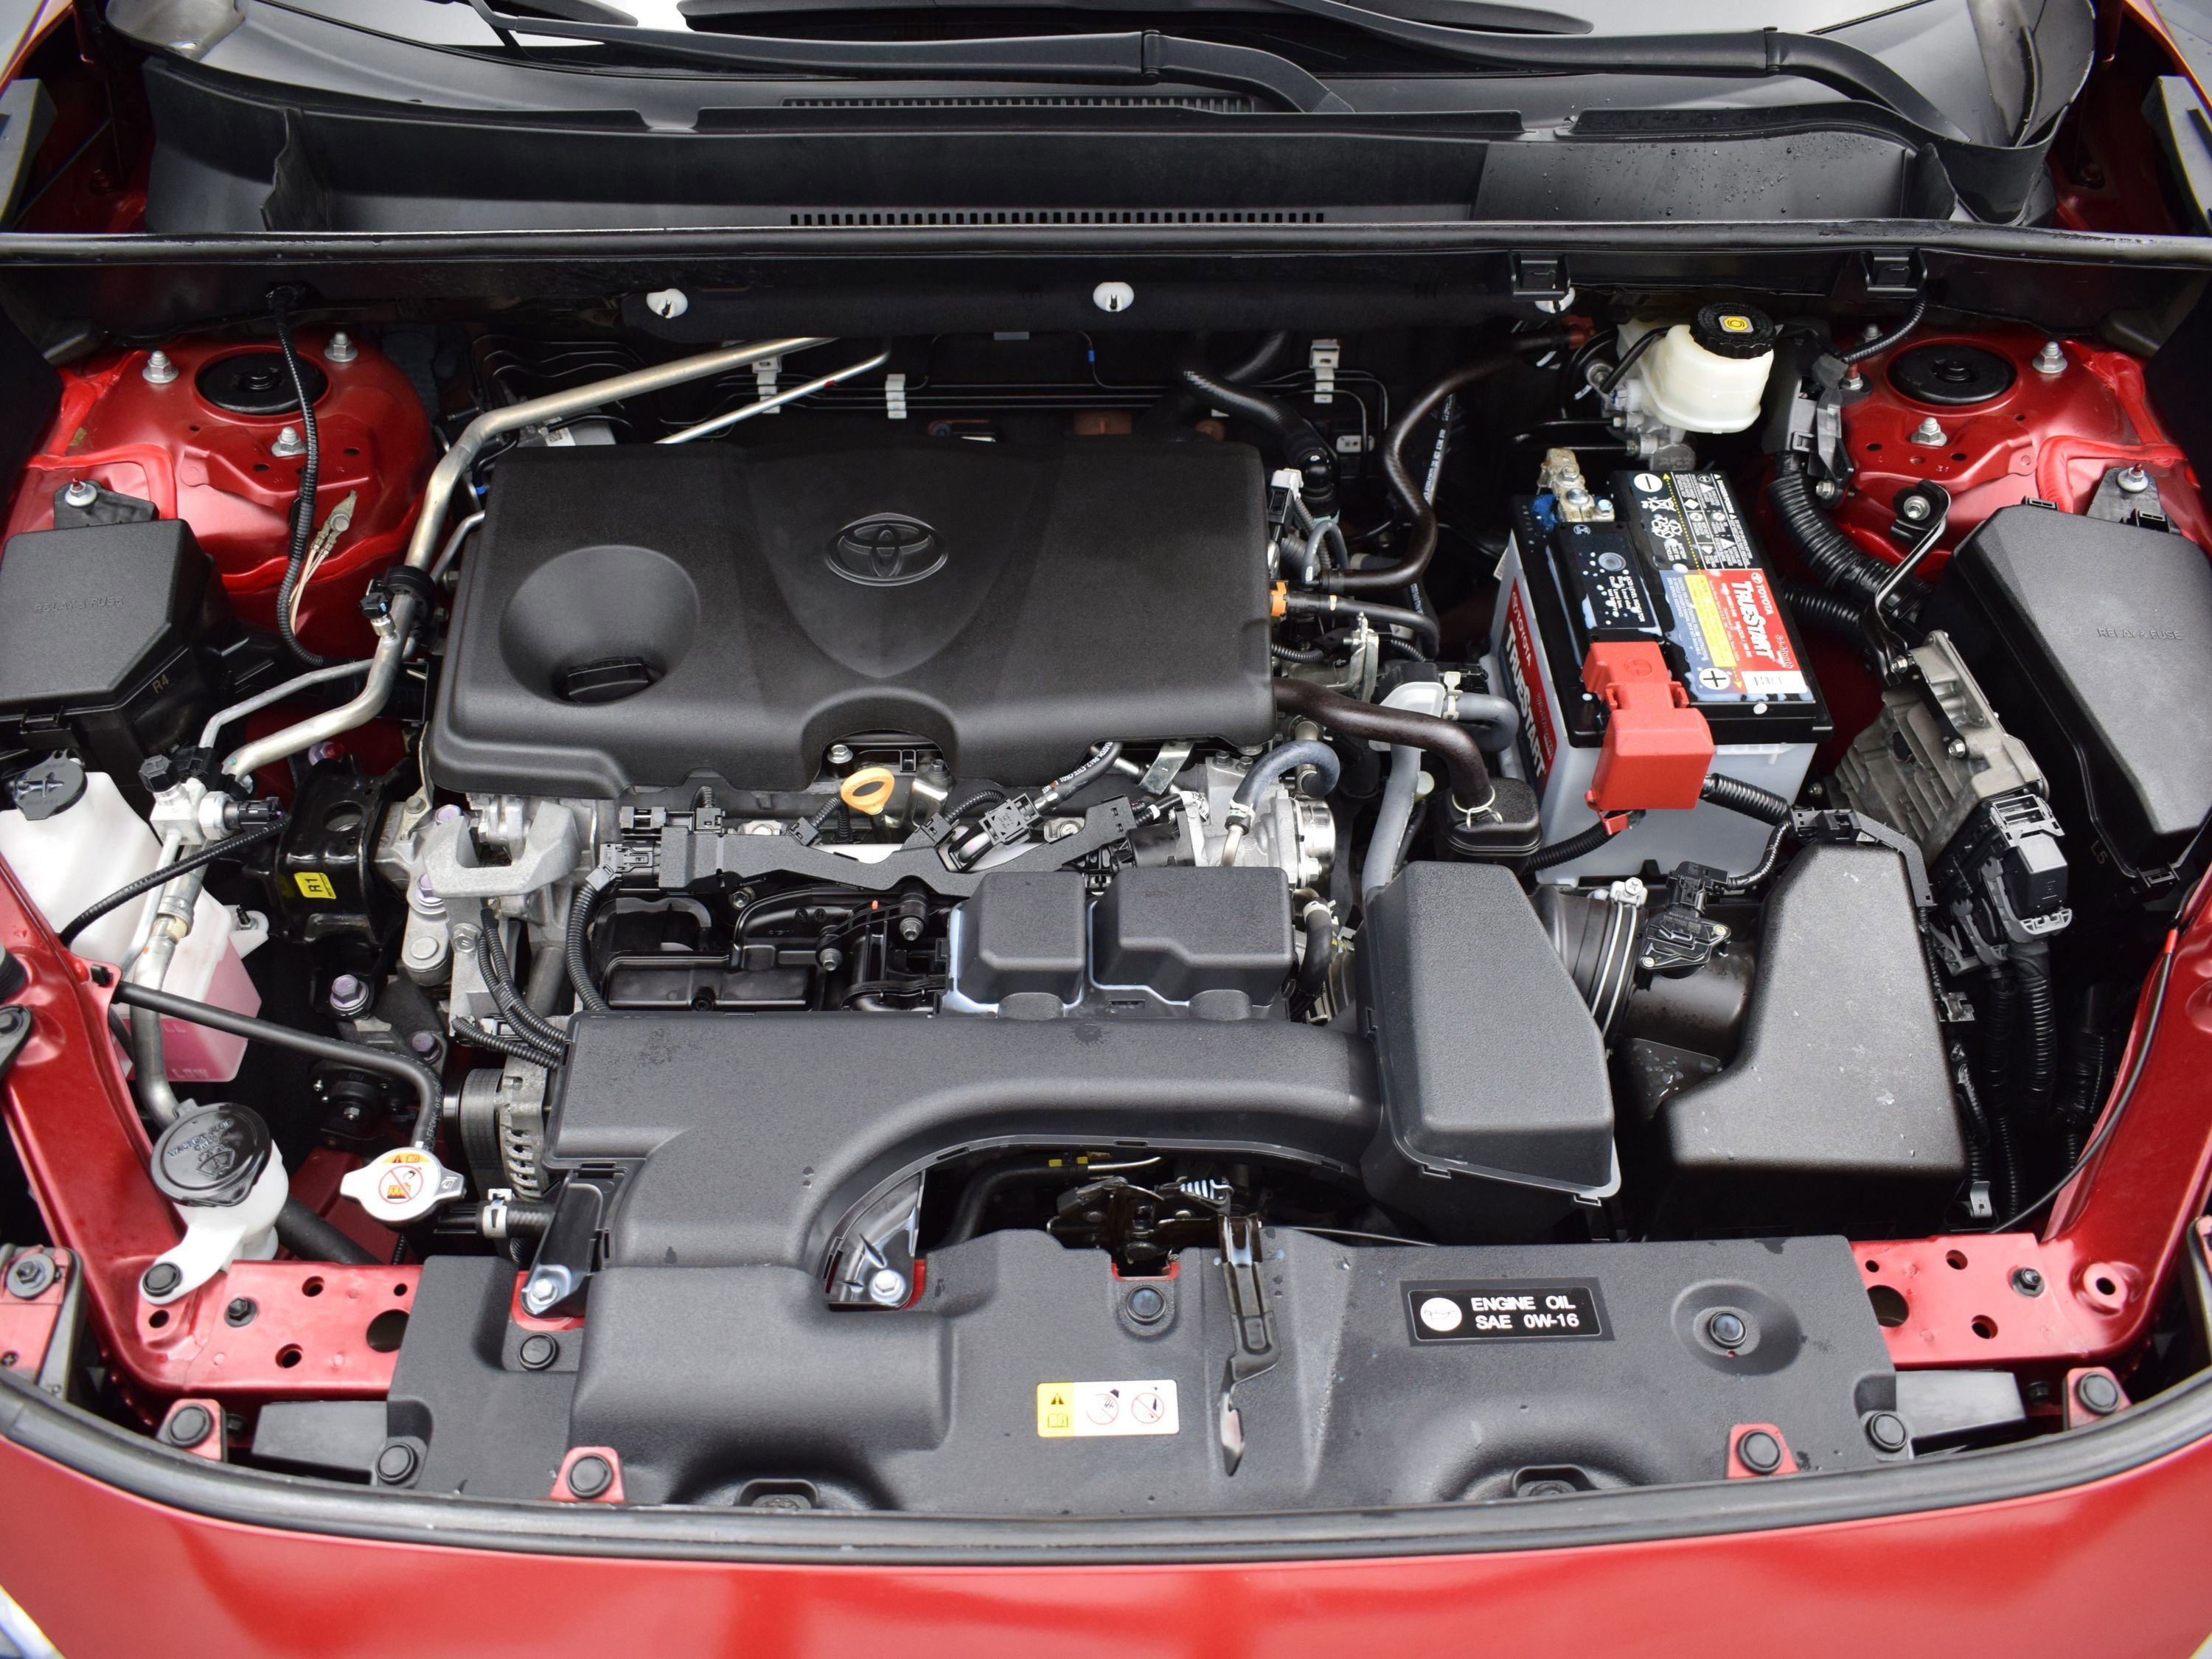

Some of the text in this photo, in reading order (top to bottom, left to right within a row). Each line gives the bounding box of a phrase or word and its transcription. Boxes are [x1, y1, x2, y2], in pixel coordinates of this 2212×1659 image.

[35, 601, 77, 613] RELAY
[90, 596, 124, 607] FUSE
[1755, 584, 1775, 614] TOYOTA
[1514, 610, 1532, 668] TOYOTA
[2097, 627, 2136, 638] RELAY
[2150, 630, 2183, 640] FUSE
[152, 674, 170, 694] R4
[2090, 839, 2107, 864] L5
[305, 879, 322, 892] R1
[1471, 1295, 1576, 1311] ENGINE OIL
[1475, 1313, 1579, 1329] SAE 0W-16
